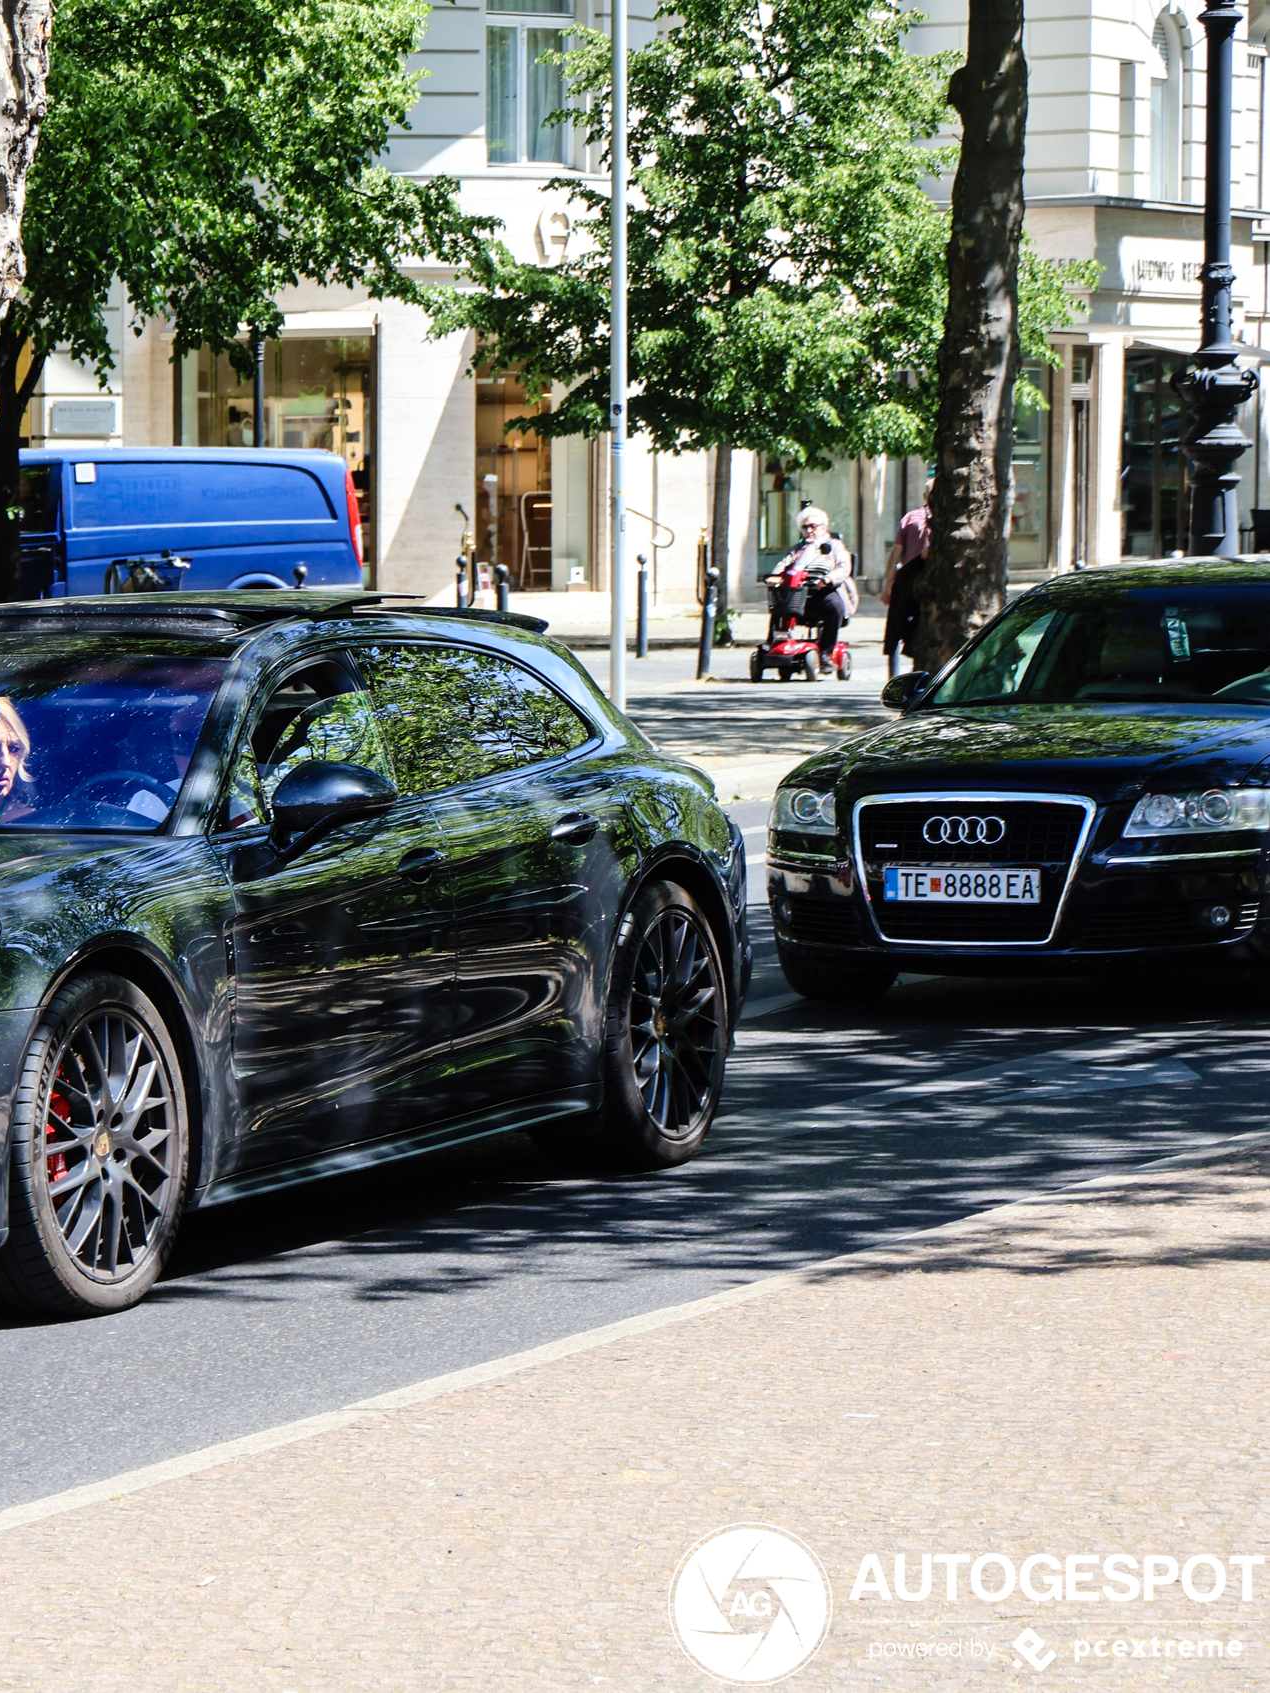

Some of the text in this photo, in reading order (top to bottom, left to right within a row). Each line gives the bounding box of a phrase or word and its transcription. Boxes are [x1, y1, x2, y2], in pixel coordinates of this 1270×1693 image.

[1137, 260, 1175, 282] LUDWIG
[201, 486, 305, 499] KUNDENDIENST
[900, 872, 928, 898] TE
